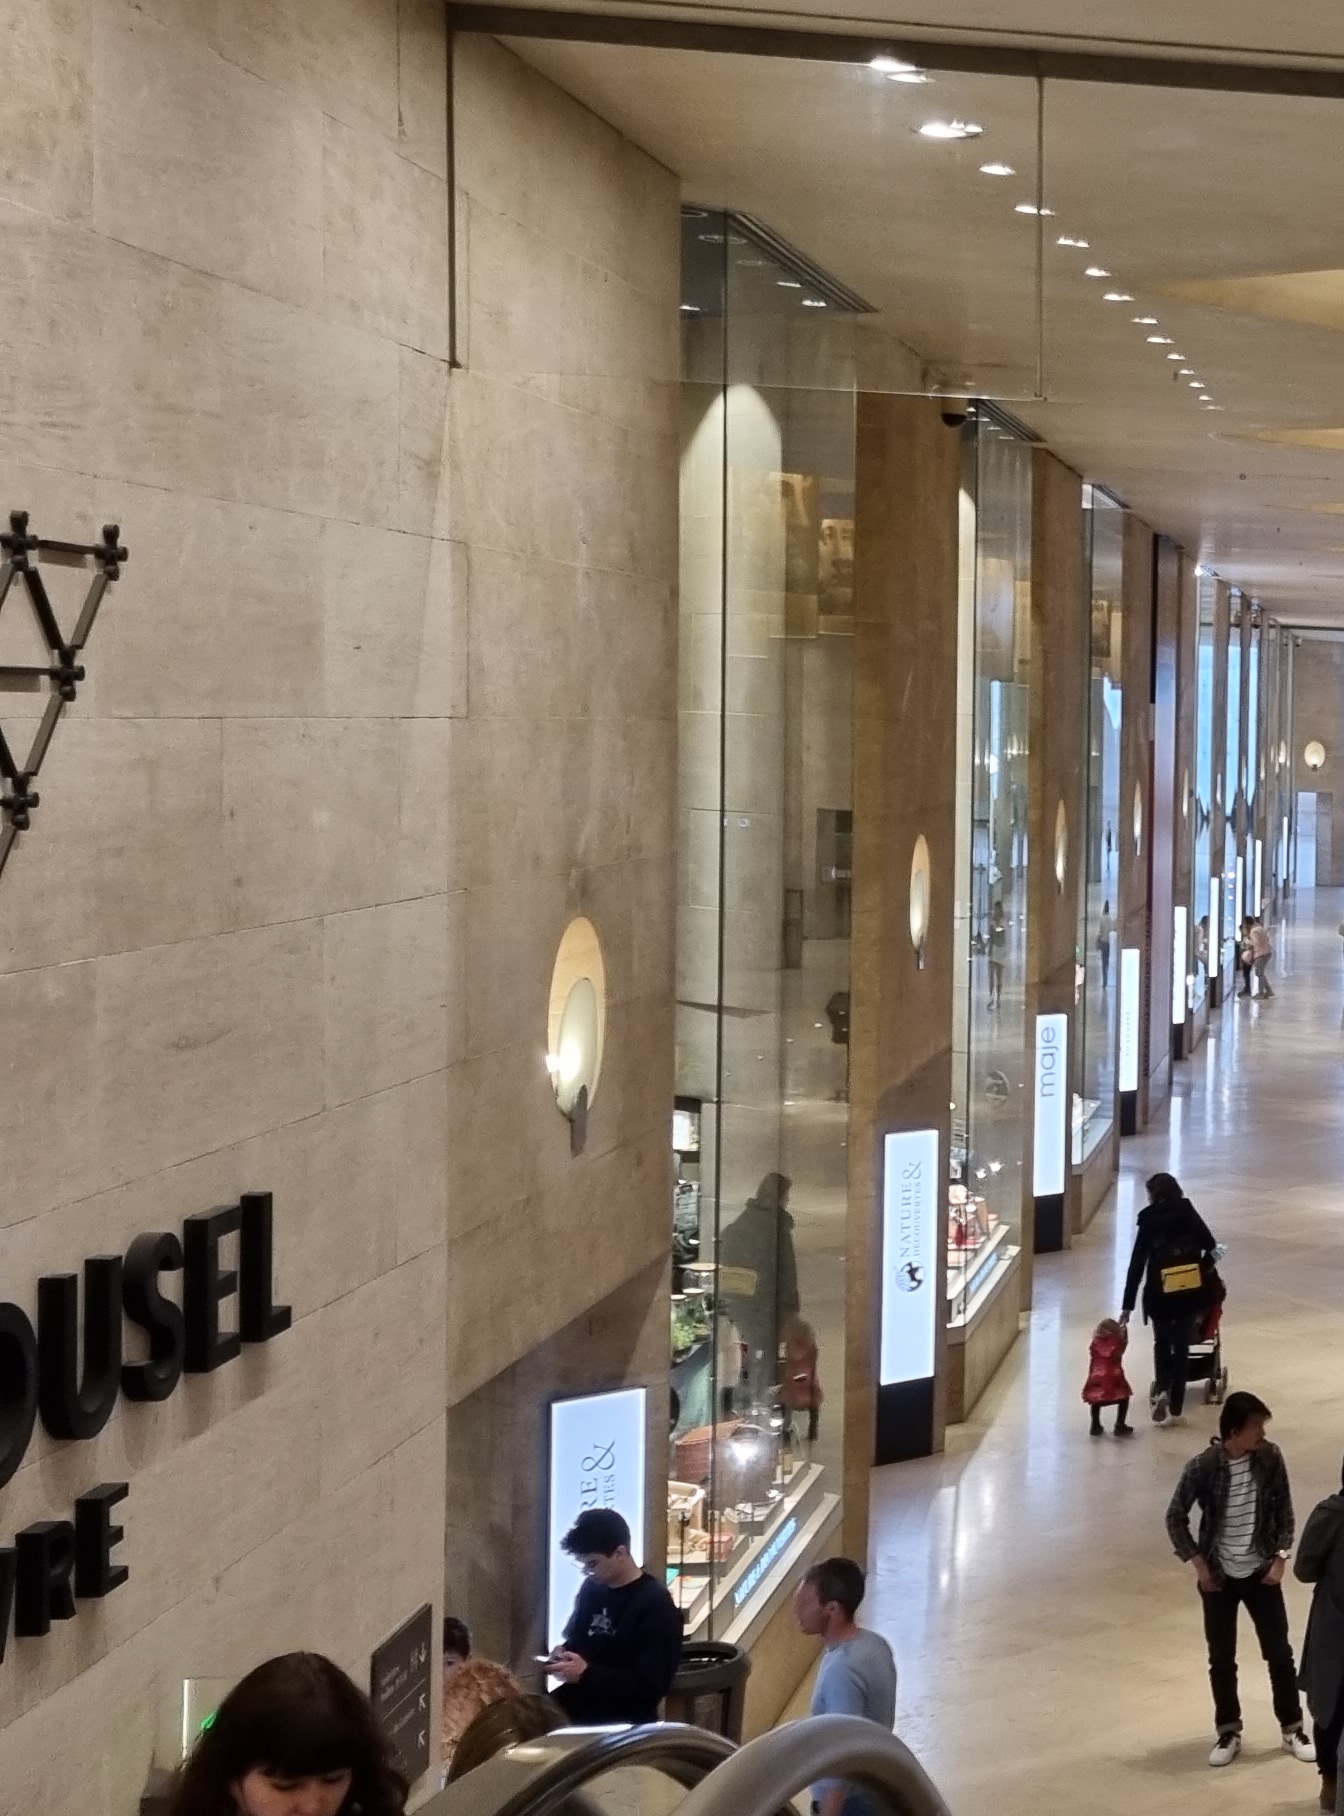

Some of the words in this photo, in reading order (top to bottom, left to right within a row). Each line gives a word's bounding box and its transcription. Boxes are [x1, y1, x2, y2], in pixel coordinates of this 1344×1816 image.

[1040, 1026, 1059, 1098] maje
[901, 1160, 922, 1180] &
[900, 1182, 912, 1258] NATURE
[580, 1439, 616, 1473] &
[0, 1482, 129, 1664] RE
